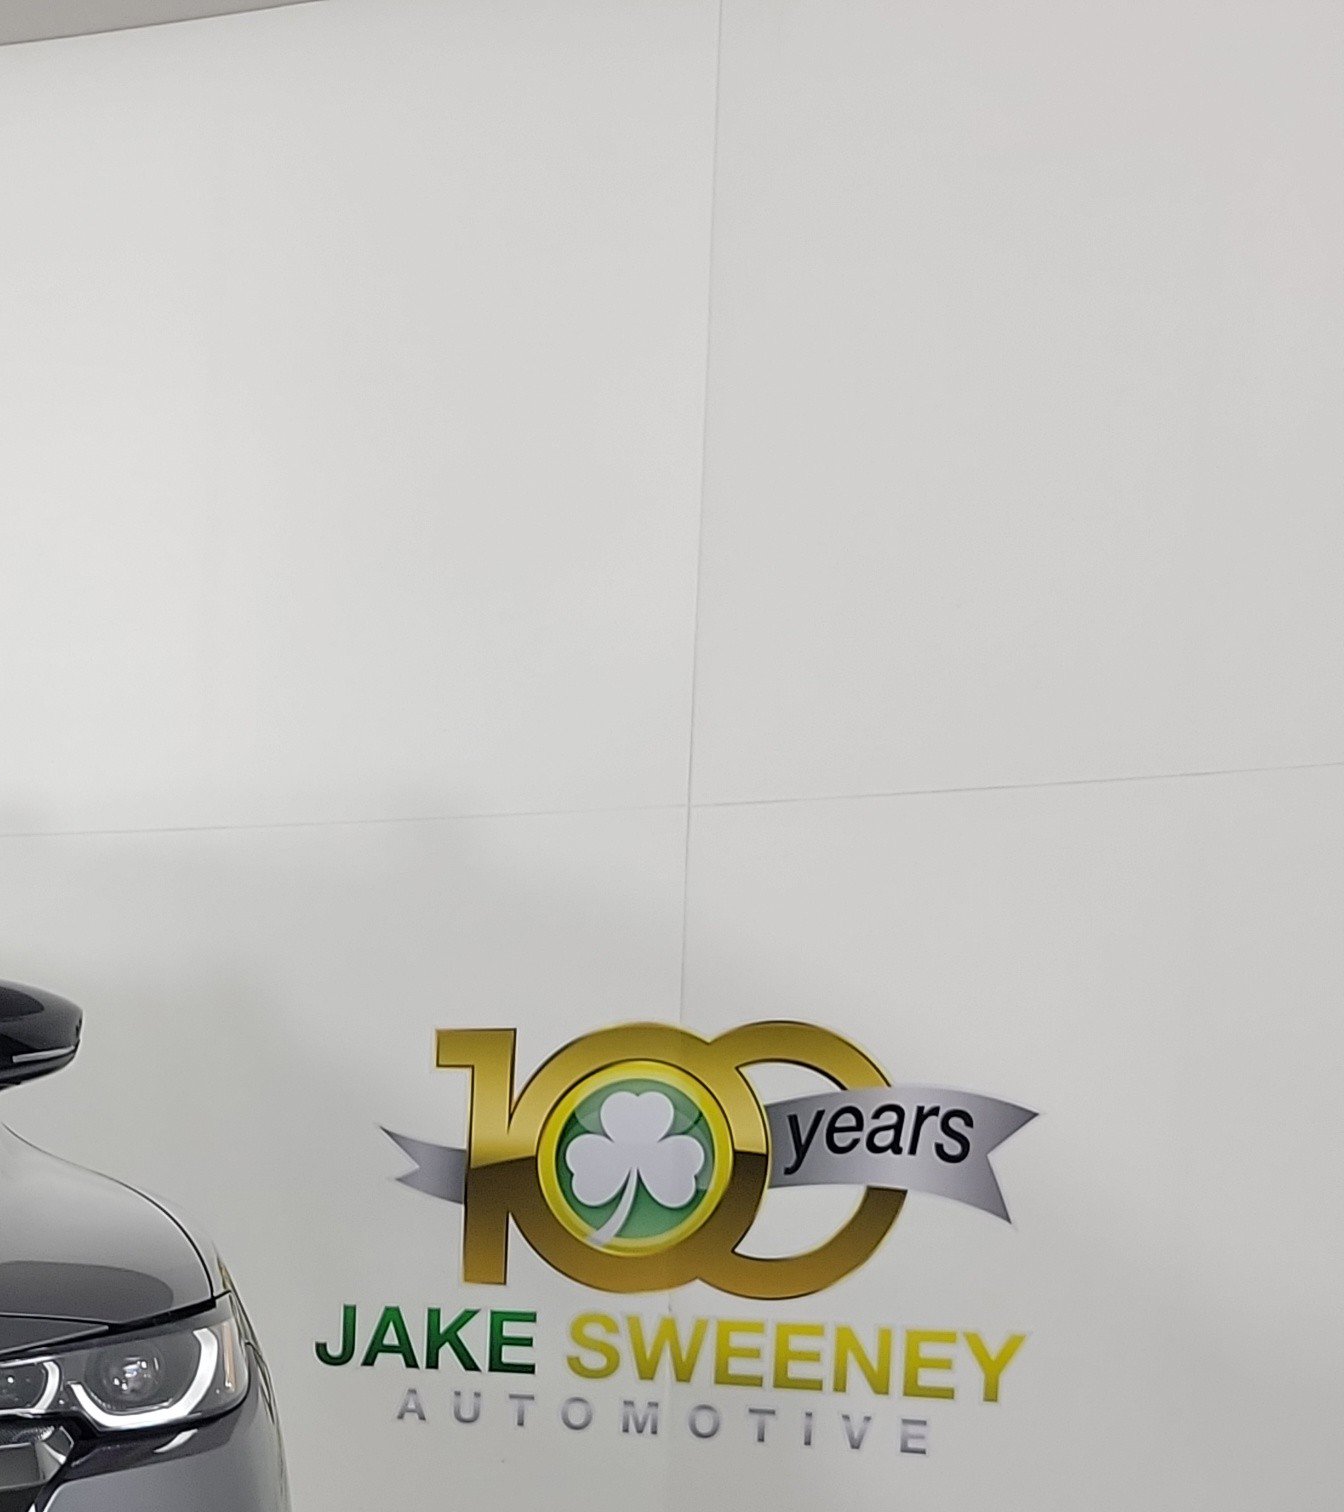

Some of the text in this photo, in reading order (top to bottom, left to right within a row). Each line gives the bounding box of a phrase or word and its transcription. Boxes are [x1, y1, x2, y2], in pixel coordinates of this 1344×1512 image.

[434, 1019, 975, 1300] 100 years
[314, 1303, 1028, 1403] JAKE SWEENEY
[396, 1387, 929, 1456] AUTOMOTIVE
